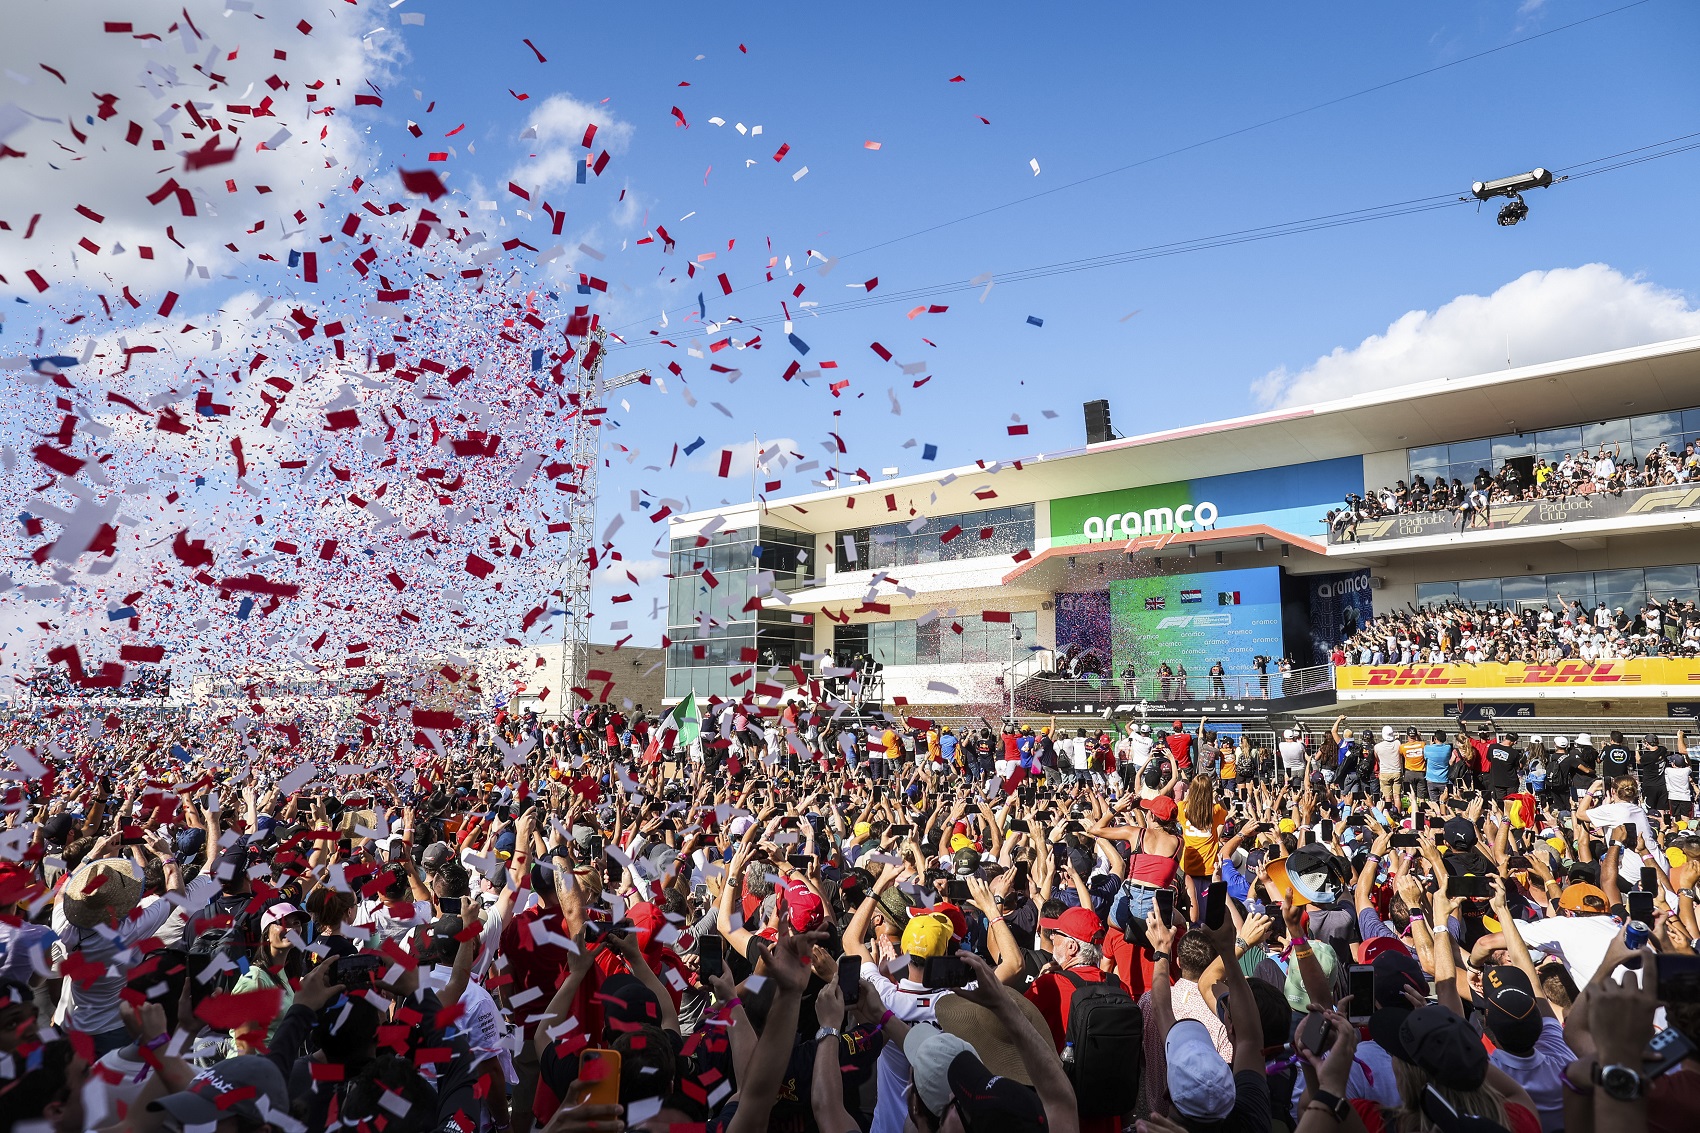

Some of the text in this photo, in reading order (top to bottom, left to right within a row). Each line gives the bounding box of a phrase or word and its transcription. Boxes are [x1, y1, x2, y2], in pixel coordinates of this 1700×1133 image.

[1539, 499, 1593, 513] Paddock
[1083, 501, 1218, 540] aramco
[1399, 513, 1446, 526] Paddock
[1539, 511, 1567, 521] Club
[1399, 524, 1423, 535] Club
[1318, 574, 1368, 597] aramco
[1366, 668, 1450, 686] DHL
[1522, 664, 1624, 683] DHL
[1480, 707, 1496, 717] FIA
